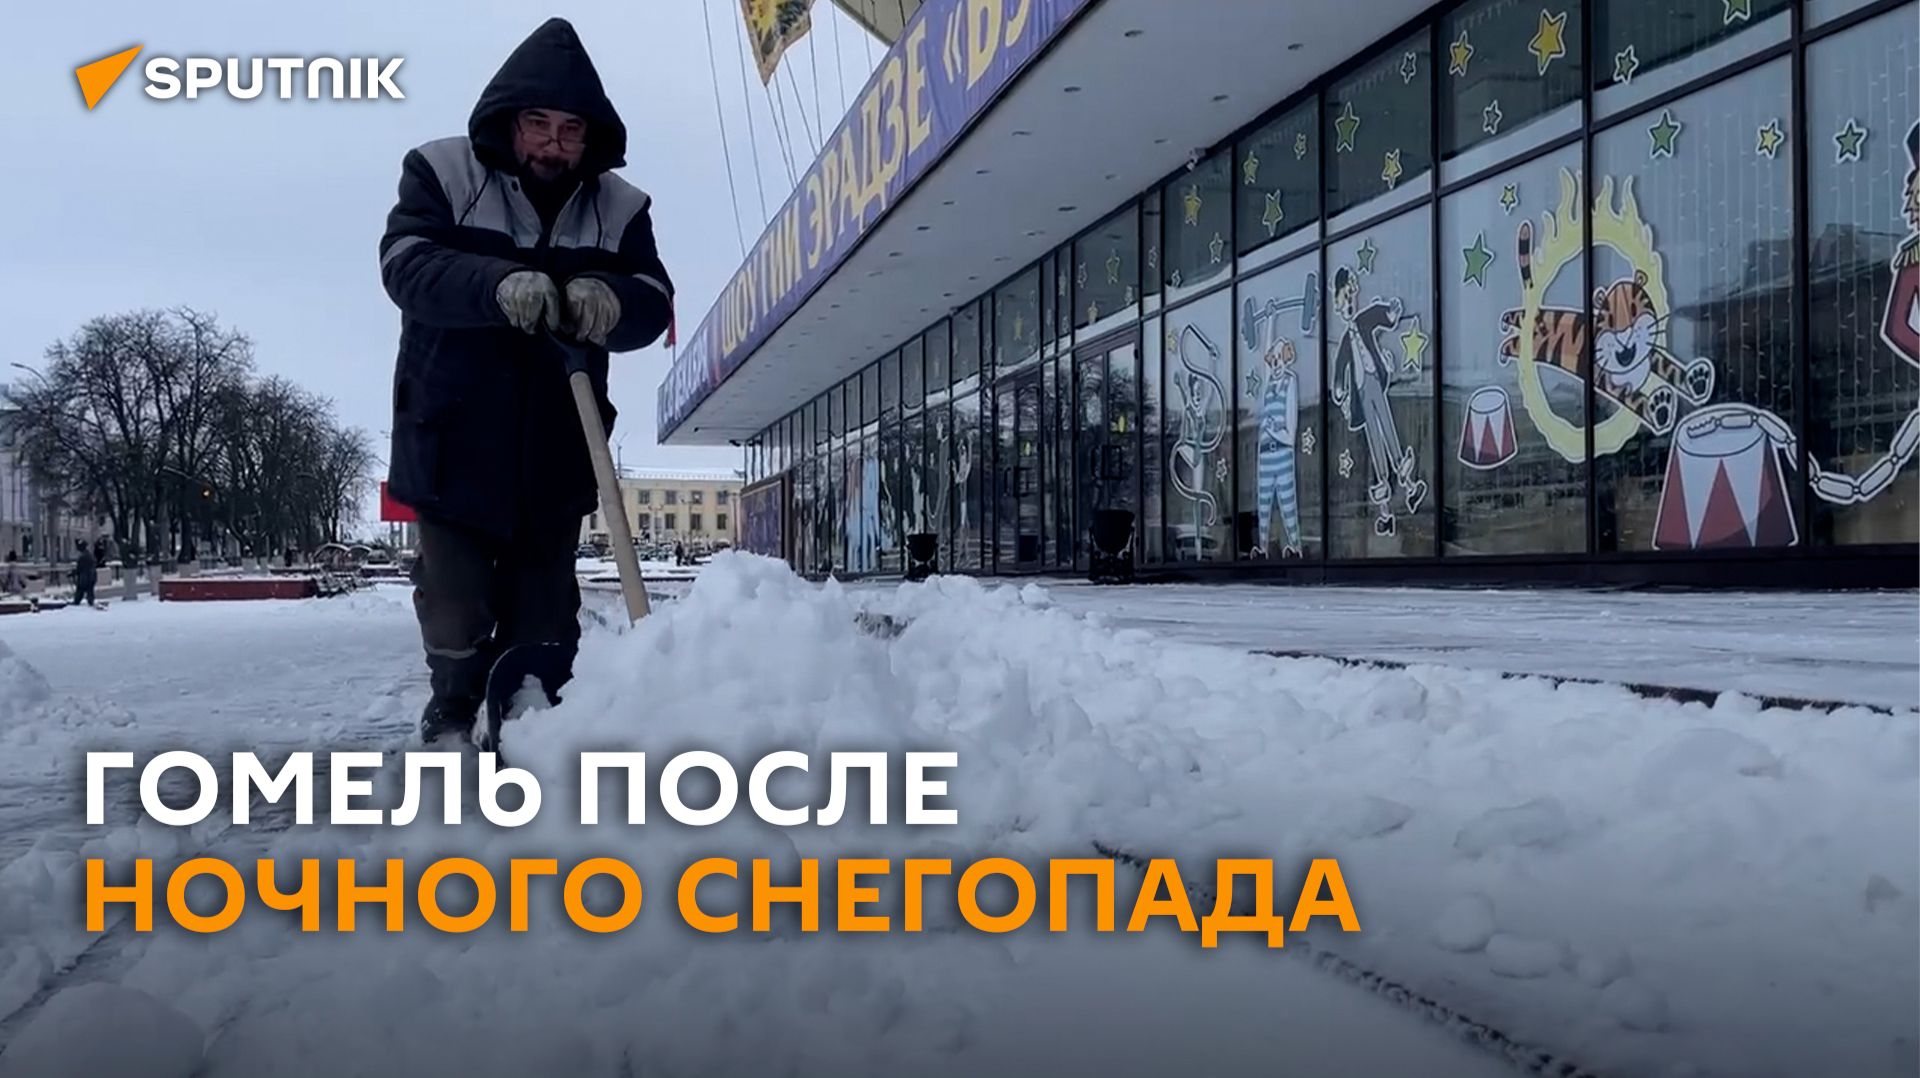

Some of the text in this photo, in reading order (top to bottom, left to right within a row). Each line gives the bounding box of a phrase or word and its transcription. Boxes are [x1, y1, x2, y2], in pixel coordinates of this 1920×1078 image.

[721, 252, 758, 359] ШОУ
[761, 196, 802, 318] ГИИ
[806, 17, 931, 270] ЭРАДЗЕ
